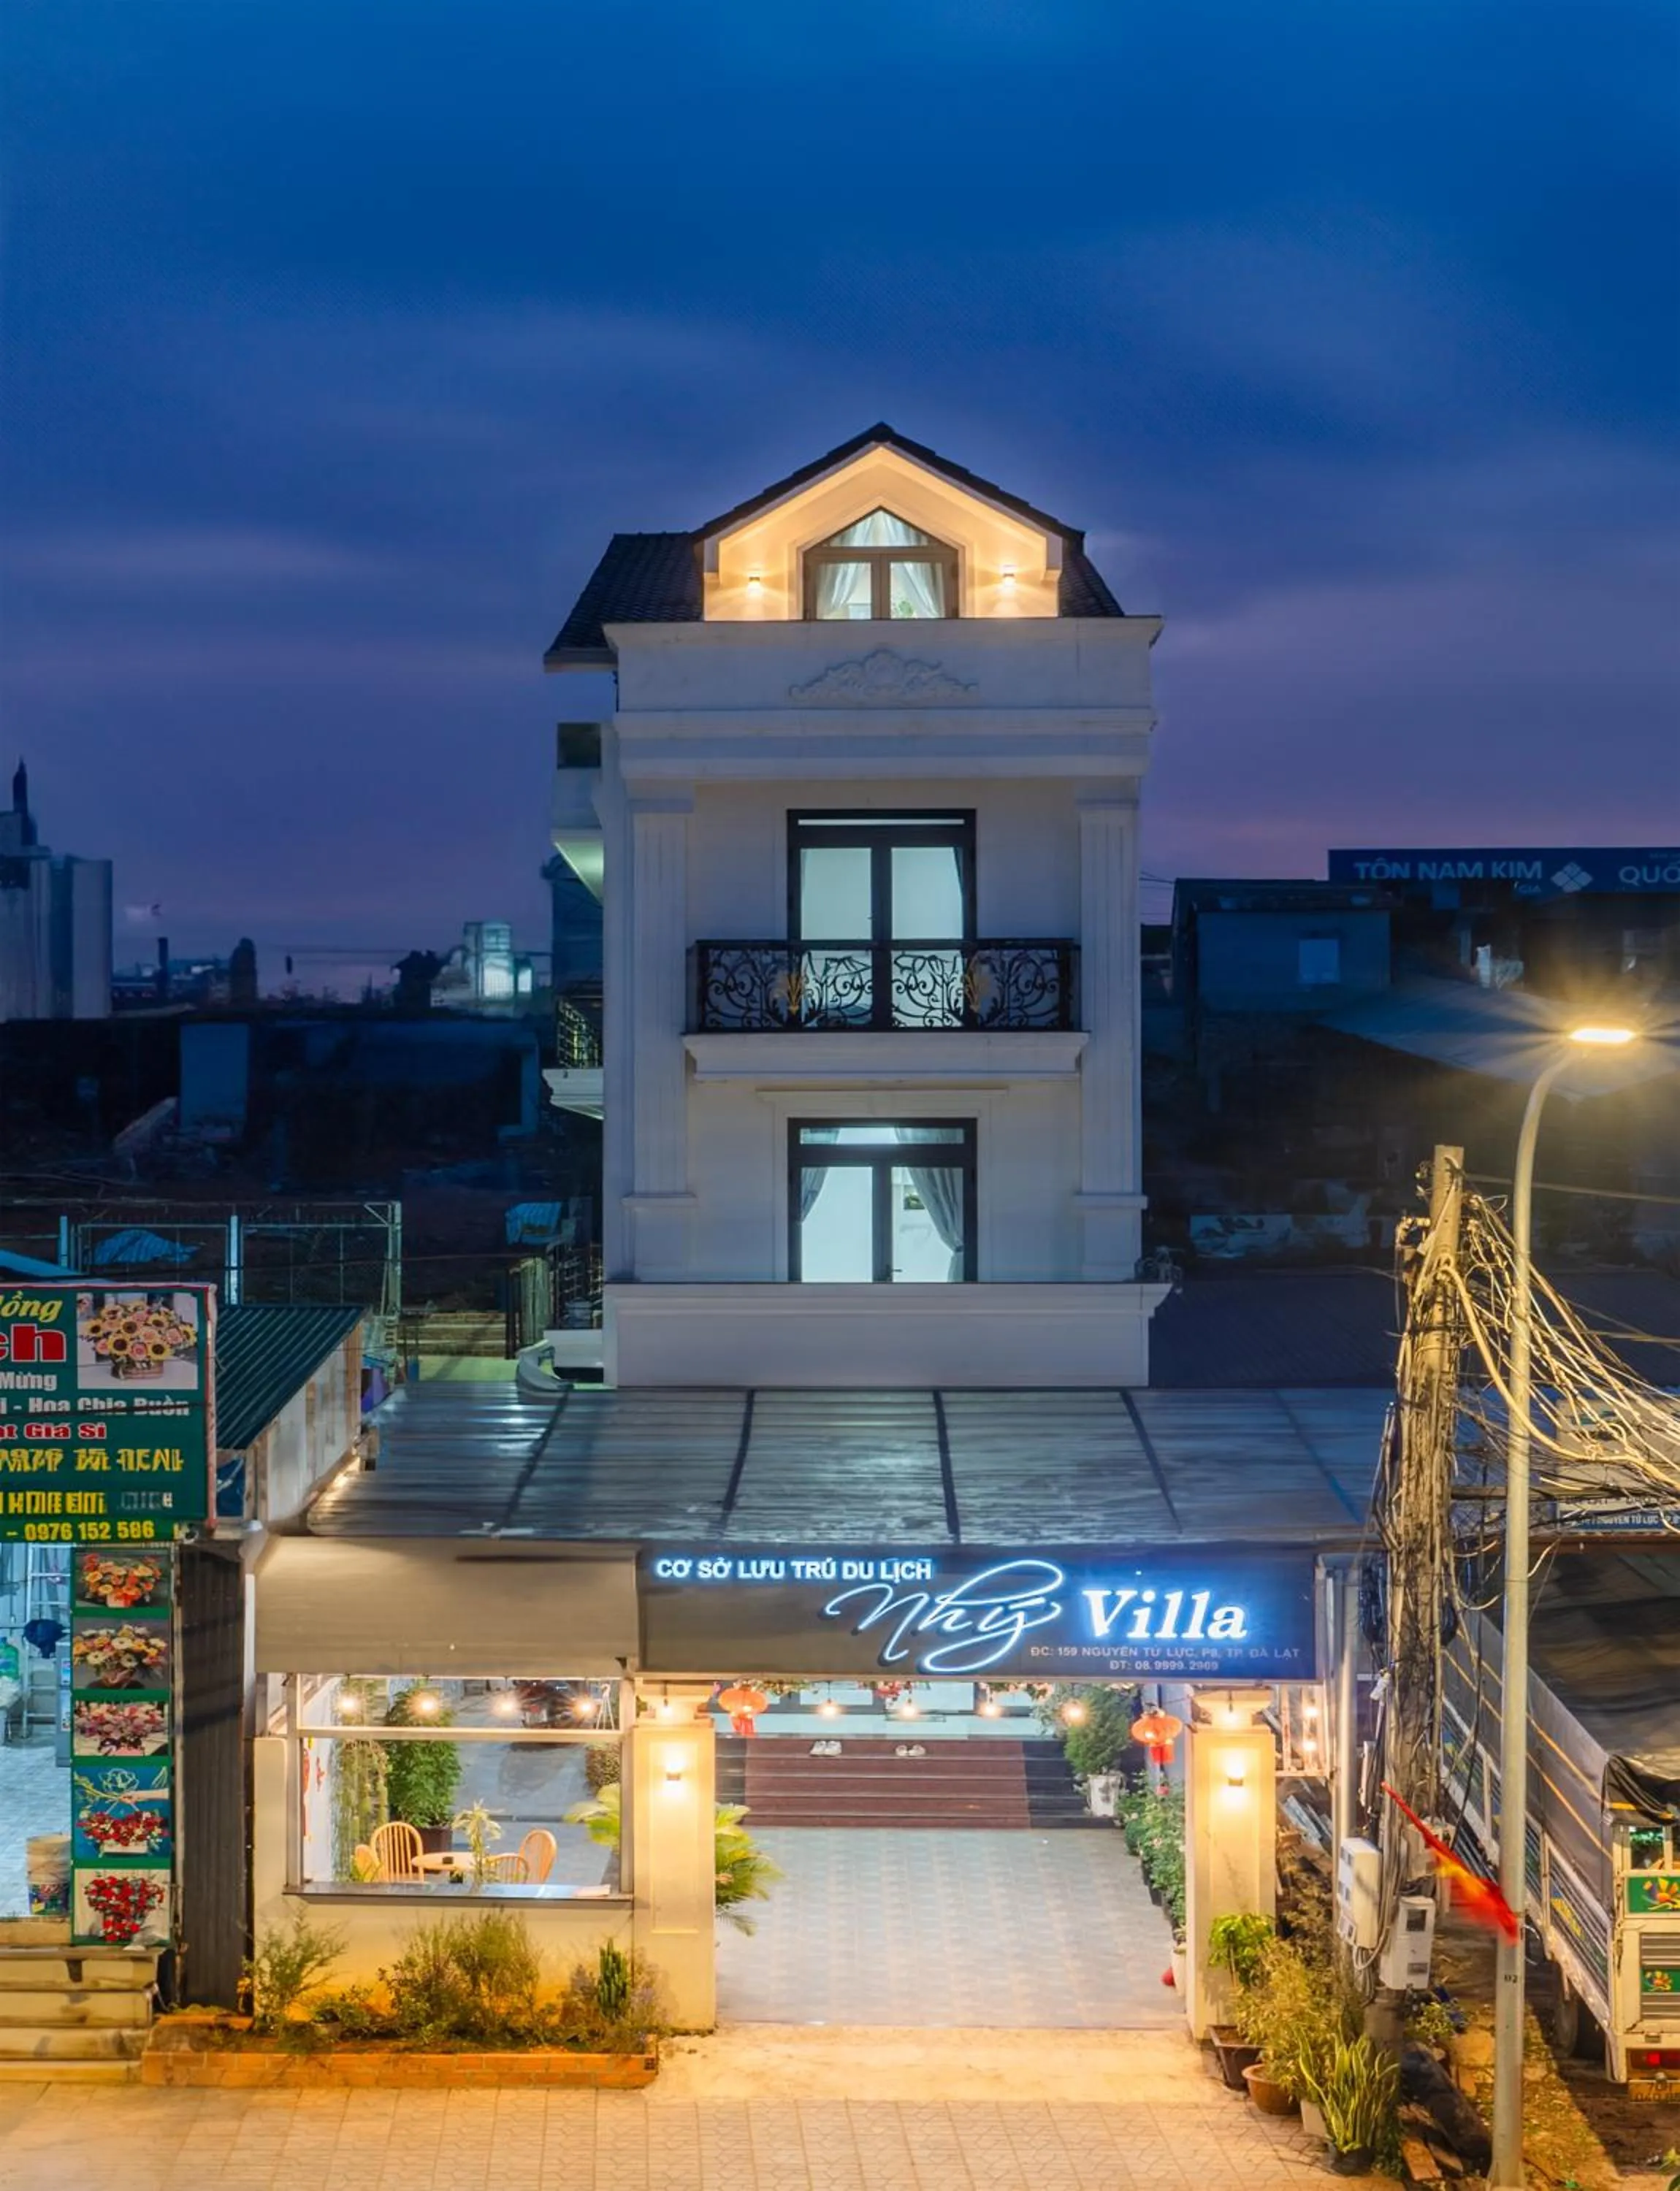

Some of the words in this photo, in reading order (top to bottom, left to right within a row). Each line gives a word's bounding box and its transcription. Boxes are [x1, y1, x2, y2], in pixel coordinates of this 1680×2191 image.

[1353, 857, 1410, 879] TÔN
[1419, 861, 1484, 880] NAM
[1491, 860, 1543, 880] KIM
[28, 1397, 71, 1413] Hoa
[24, 1422, 70, 1439] Giá
[25, 1523, 72, 1541] 0976
[78, 1521, 111, 1540] 152
[657, 1559, 692, 1578] CƠ
[698, 1556, 730, 1578] SỞ
[738, 1559, 785, 1578] LƯU
[791, 1557, 836, 1579] TRÚ
[842, 1561, 874, 1579] DU
[880, 1561, 932, 1583] LỊCH
[1081, 1588, 1248, 1640] Villa
